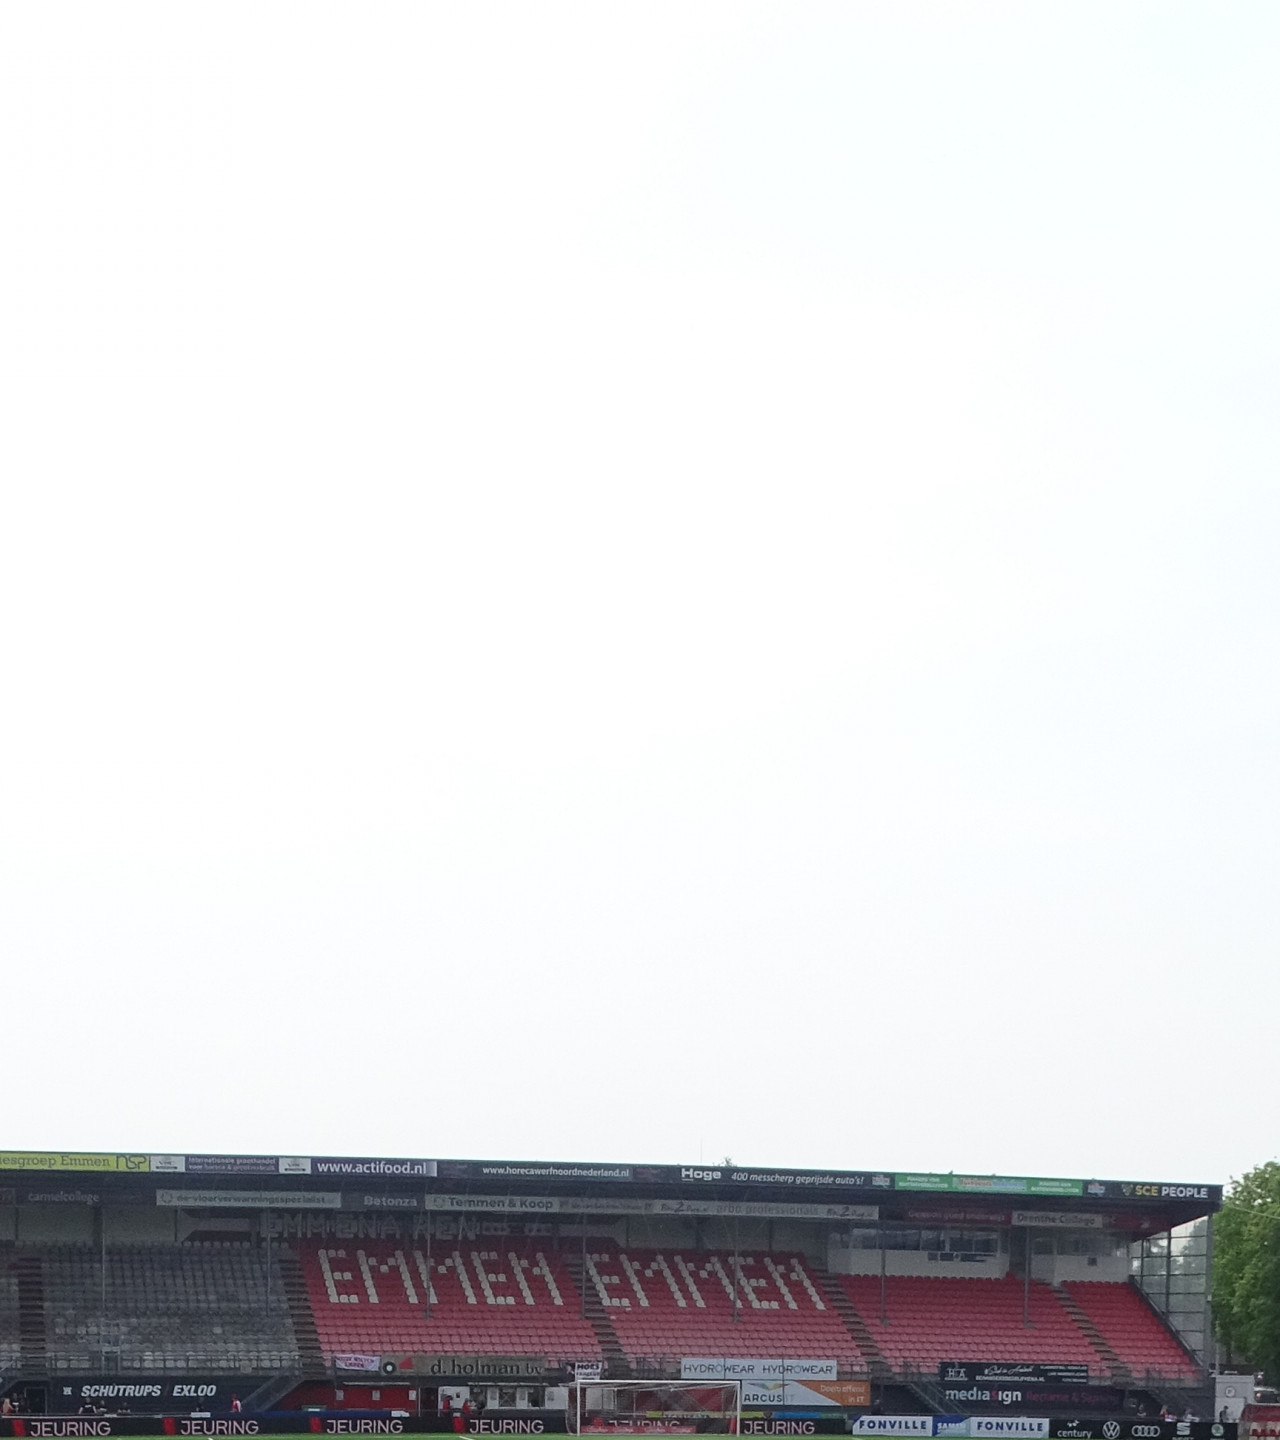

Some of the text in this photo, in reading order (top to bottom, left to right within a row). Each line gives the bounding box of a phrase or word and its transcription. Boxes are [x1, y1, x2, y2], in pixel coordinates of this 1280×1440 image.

[60, 1154, 111, 1167] Emmen
[317, 1160, 427, 1176] www.actifood.nl
[681, 1167, 722, 1180] Hoge
[731, 1172, 748, 1182] 400
[750, 1173, 794, 1184] messcherp
[795, 1174, 833, 1185] geprijsde
[835, 1175, 864, 1185] auto's!
[1135, 1185, 1209, 1199] SCE PEOPLE
[364, 1195, 418, 1208] Betonza
[448, 1197, 553, 1211] Temmen & Koop
[318, 1249, 827, 1312] EMMEN EMMEN
[430, 1359, 447, 1375] d.
[451, 1359, 520, 1376] holman
[683, 1363, 834, 1375] HYDROWEAR HYDROWEAR
[81, 1384, 217, 1398] SCHUTRUPS EXLOO
[743, 1393, 783, 1403] ARCUS
[29, 1421, 111, 1437] JEURING
[180, 1420, 259, 1436] JEURING
[326, 1418, 404, 1435] JEURING
[469, 1418, 545, 1435] JEURING
[743, 1420, 815, 1435] JEURING
[858, 1419, 928, 1432] FONVILLE
[977, 1421, 1044, 1433] FONVILLE
[1057, 1427, 1093, 1439] century
